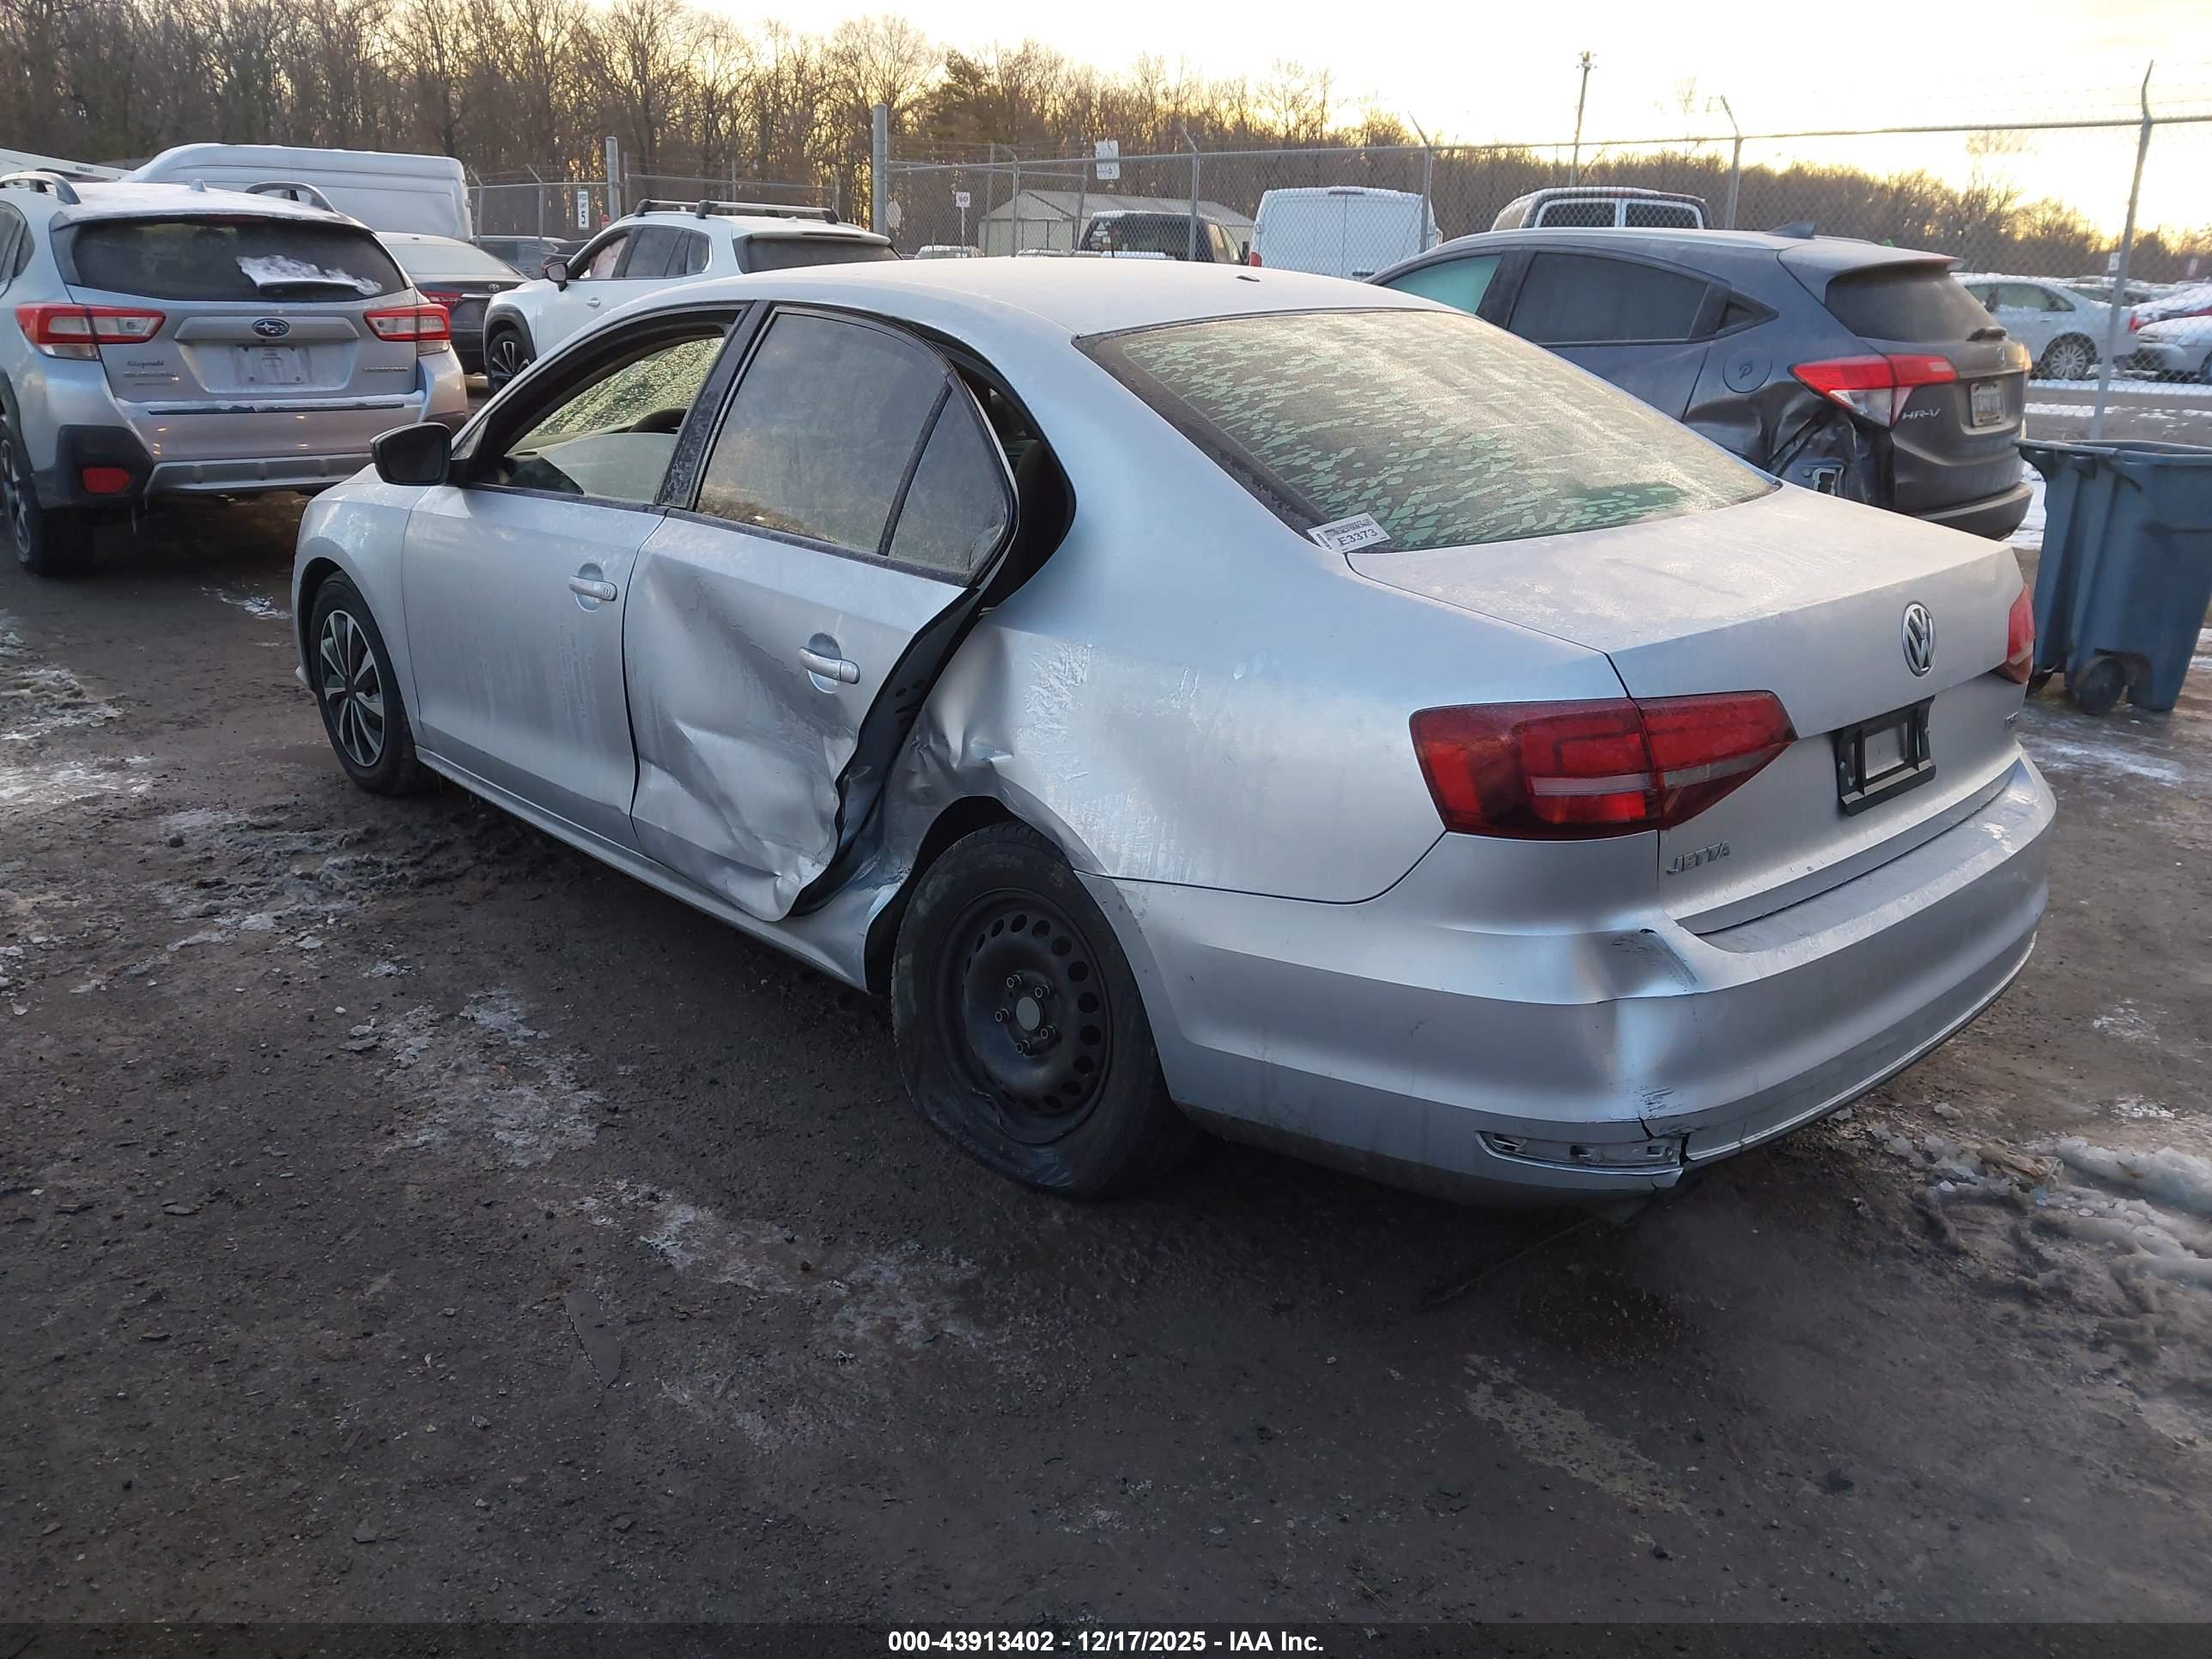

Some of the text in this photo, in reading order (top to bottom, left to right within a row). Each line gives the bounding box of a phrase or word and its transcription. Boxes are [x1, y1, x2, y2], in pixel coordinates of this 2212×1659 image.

[581, 210, 586, 224] 5
[1902, 408, 1941, 419] HR-V
[1338, 528, 1377, 545] E3373
[1667, 841, 1730, 874] JETTA
